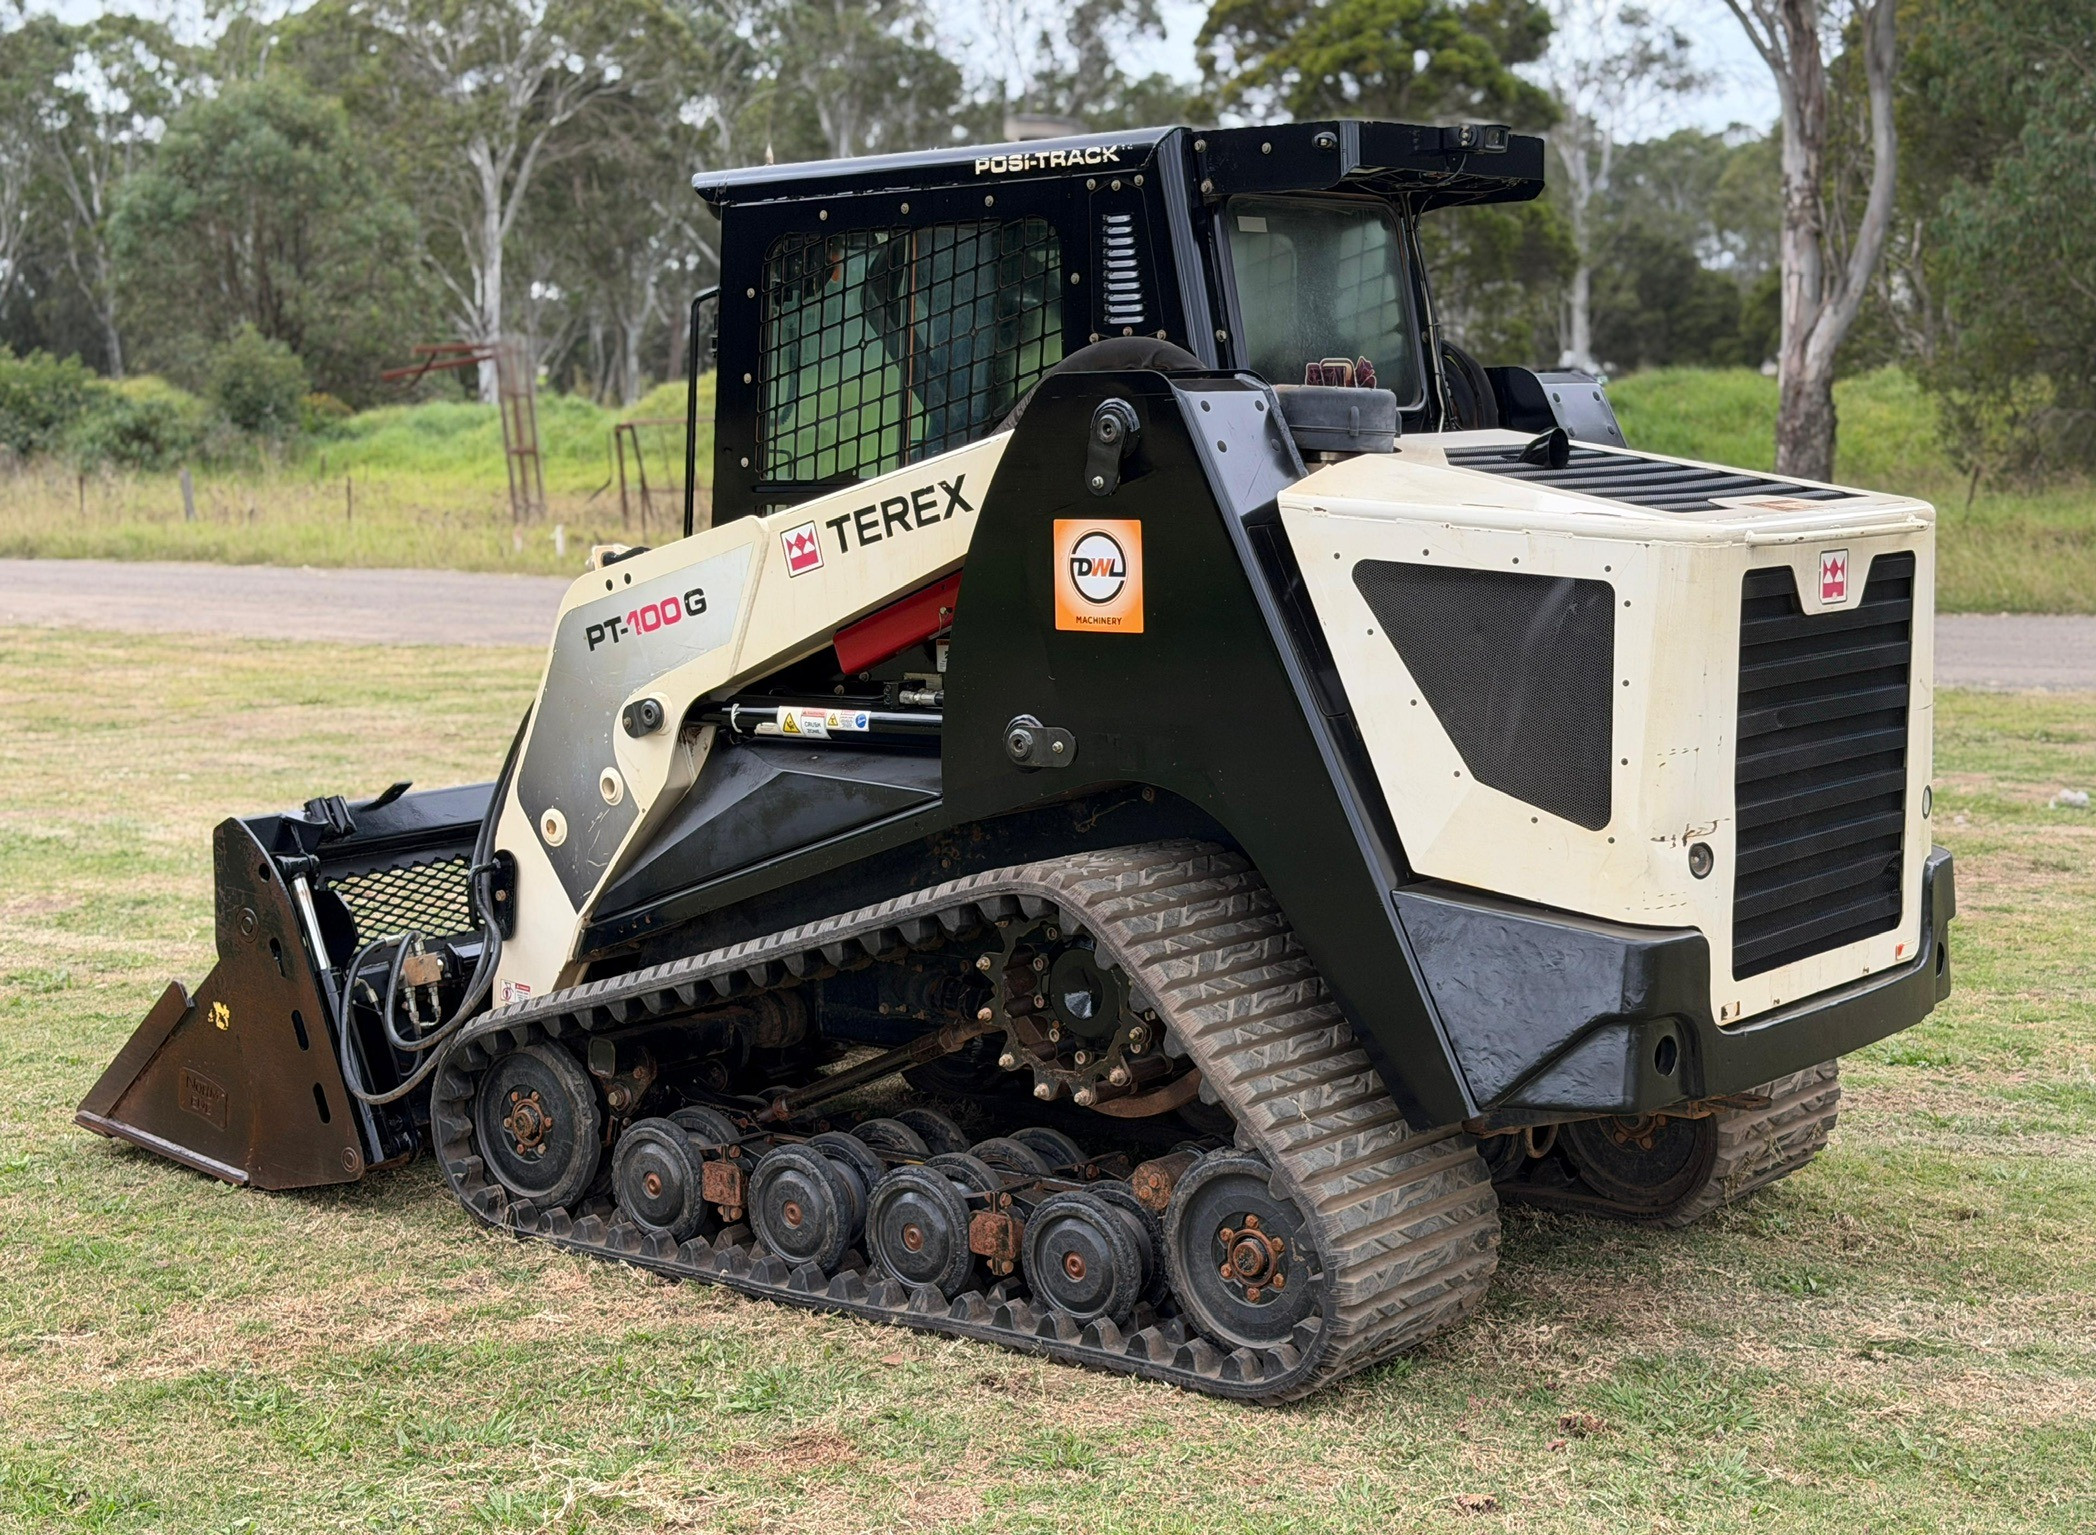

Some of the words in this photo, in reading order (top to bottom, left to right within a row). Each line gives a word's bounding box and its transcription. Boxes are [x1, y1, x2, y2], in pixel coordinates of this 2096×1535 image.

[826, 474, 974, 554] TEREX
[1070, 557, 1126, 577] DWL
[1076, 616, 1122, 625] MACHINERY
